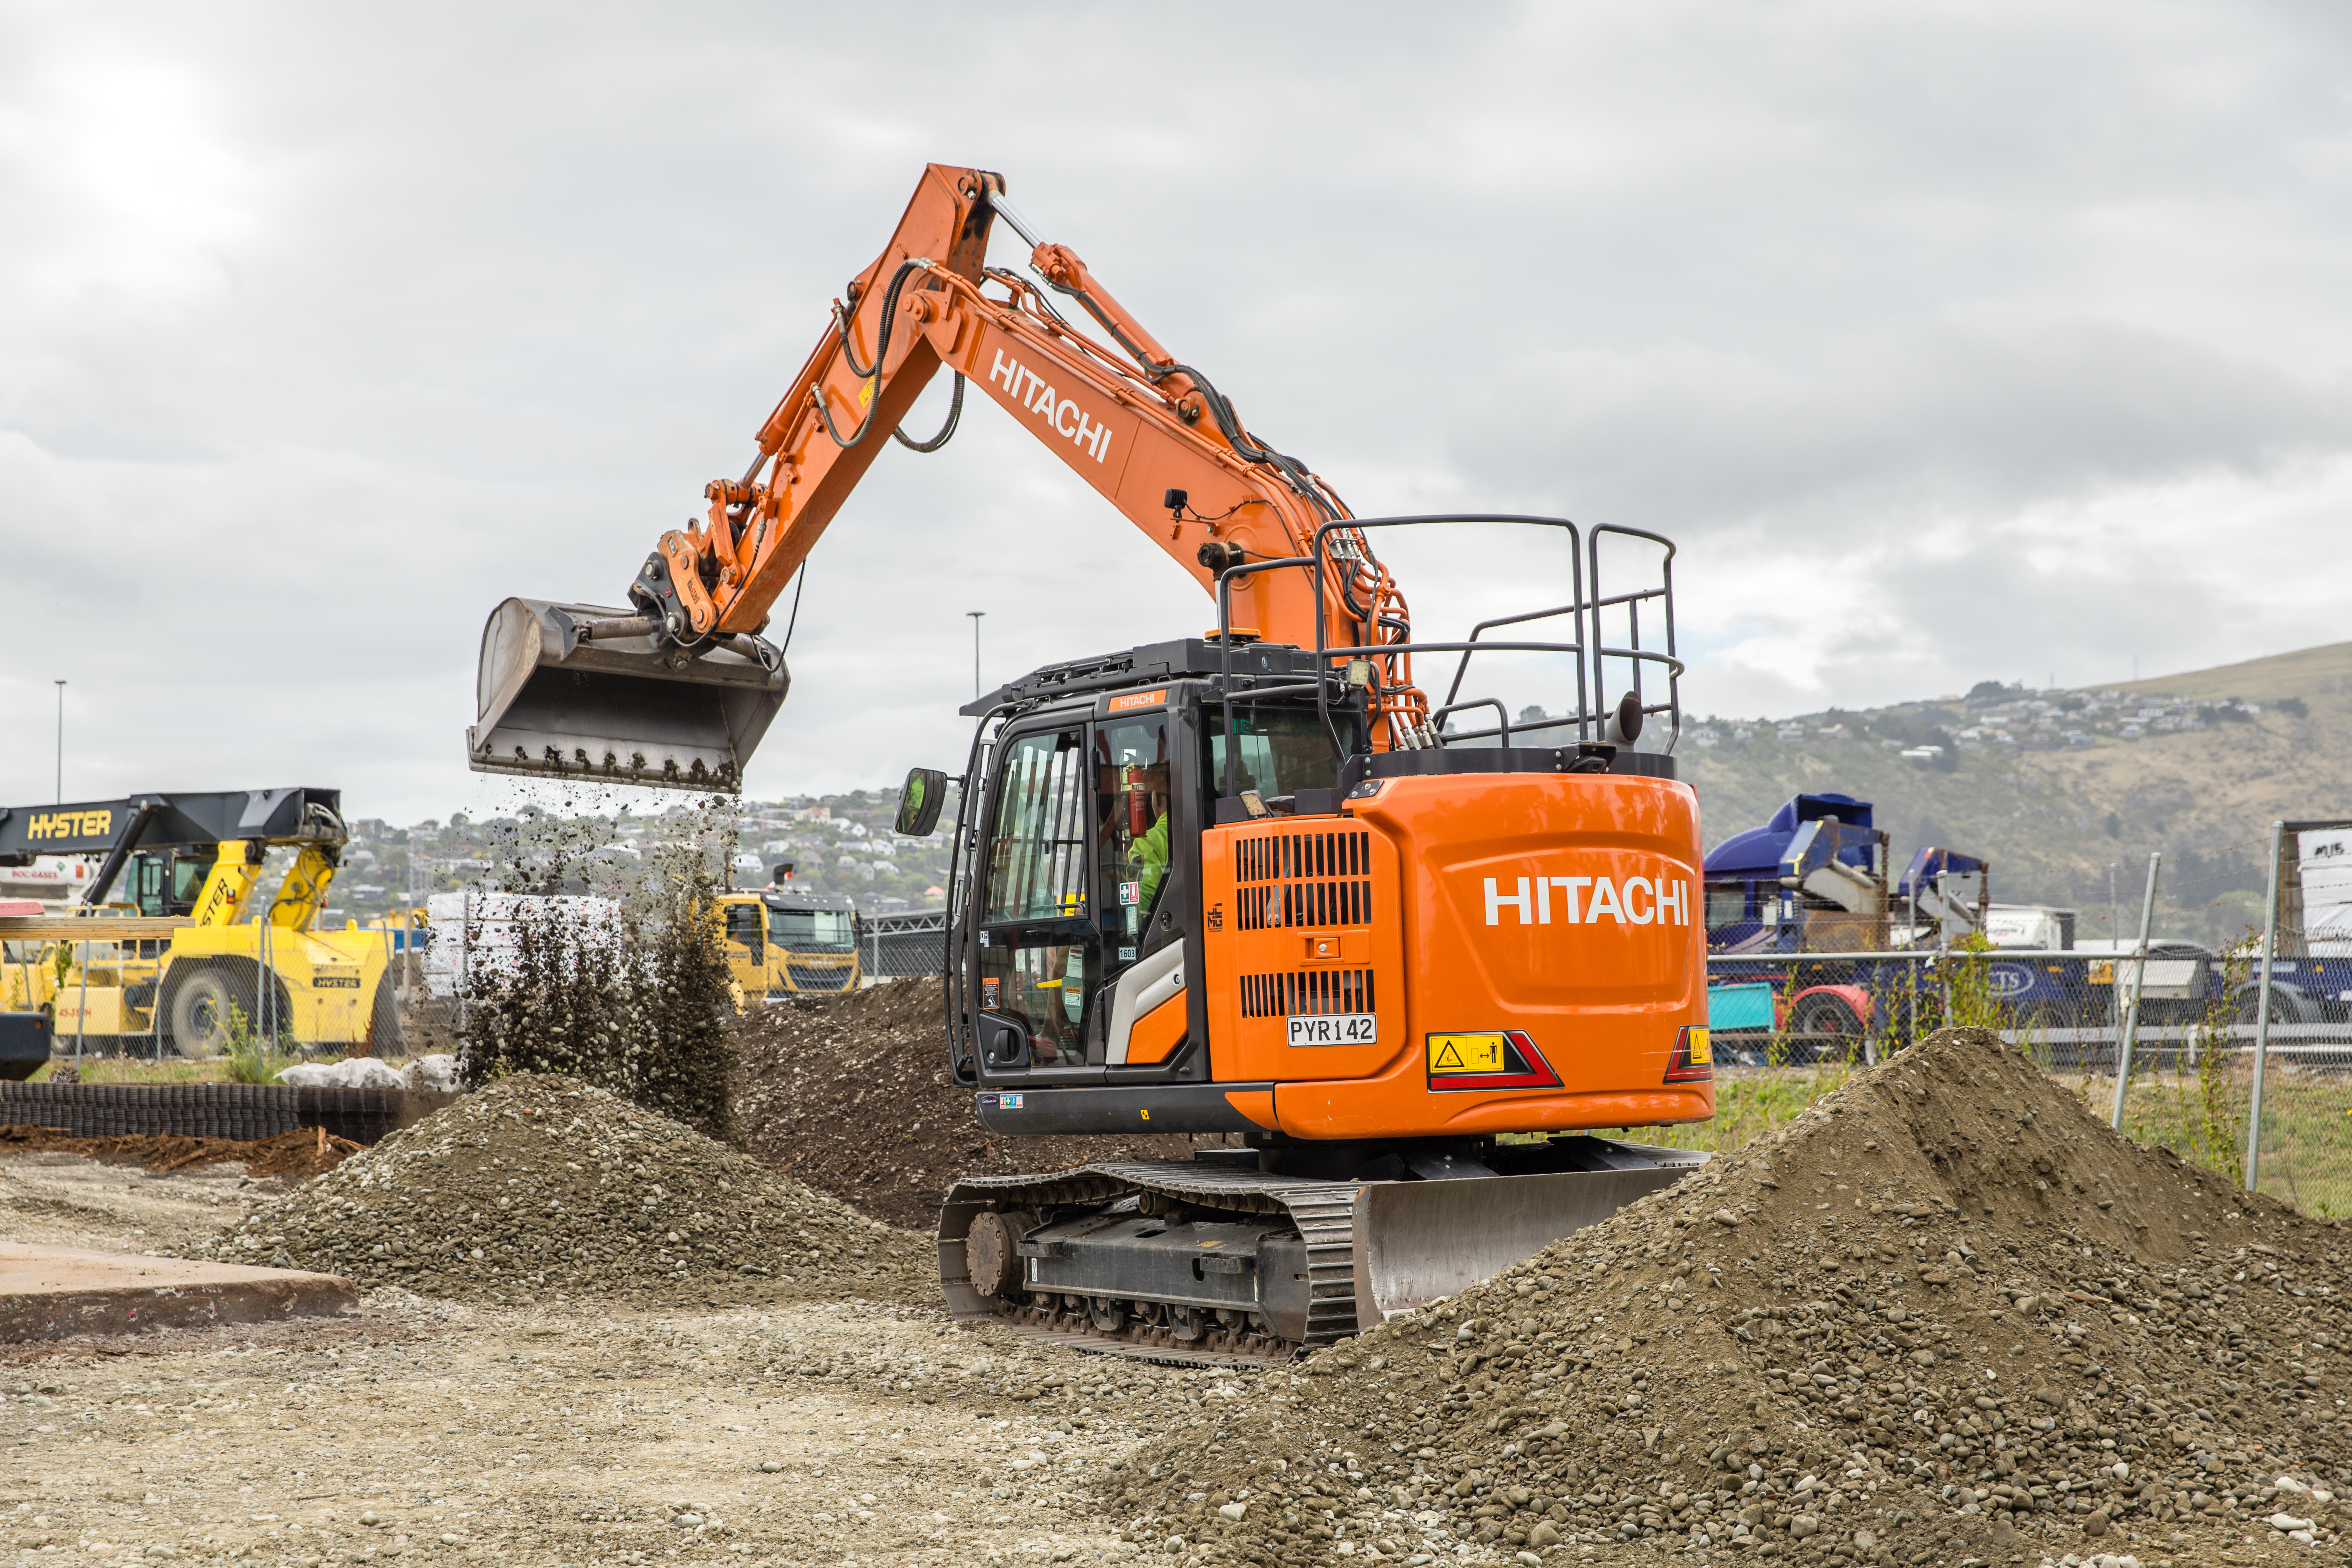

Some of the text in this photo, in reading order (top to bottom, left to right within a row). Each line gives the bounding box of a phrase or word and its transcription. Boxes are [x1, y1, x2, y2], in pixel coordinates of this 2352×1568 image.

[989, 348, 1112, 464] HITACHI
[1120, 693, 1154, 708] HITACHI
[27, 809, 112, 840] HYSTER
[1484, 876, 1688, 926] HITACHI
[1120, 949, 1135, 958] 1603
[1290, 1019, 1373, 1042] PYR142
